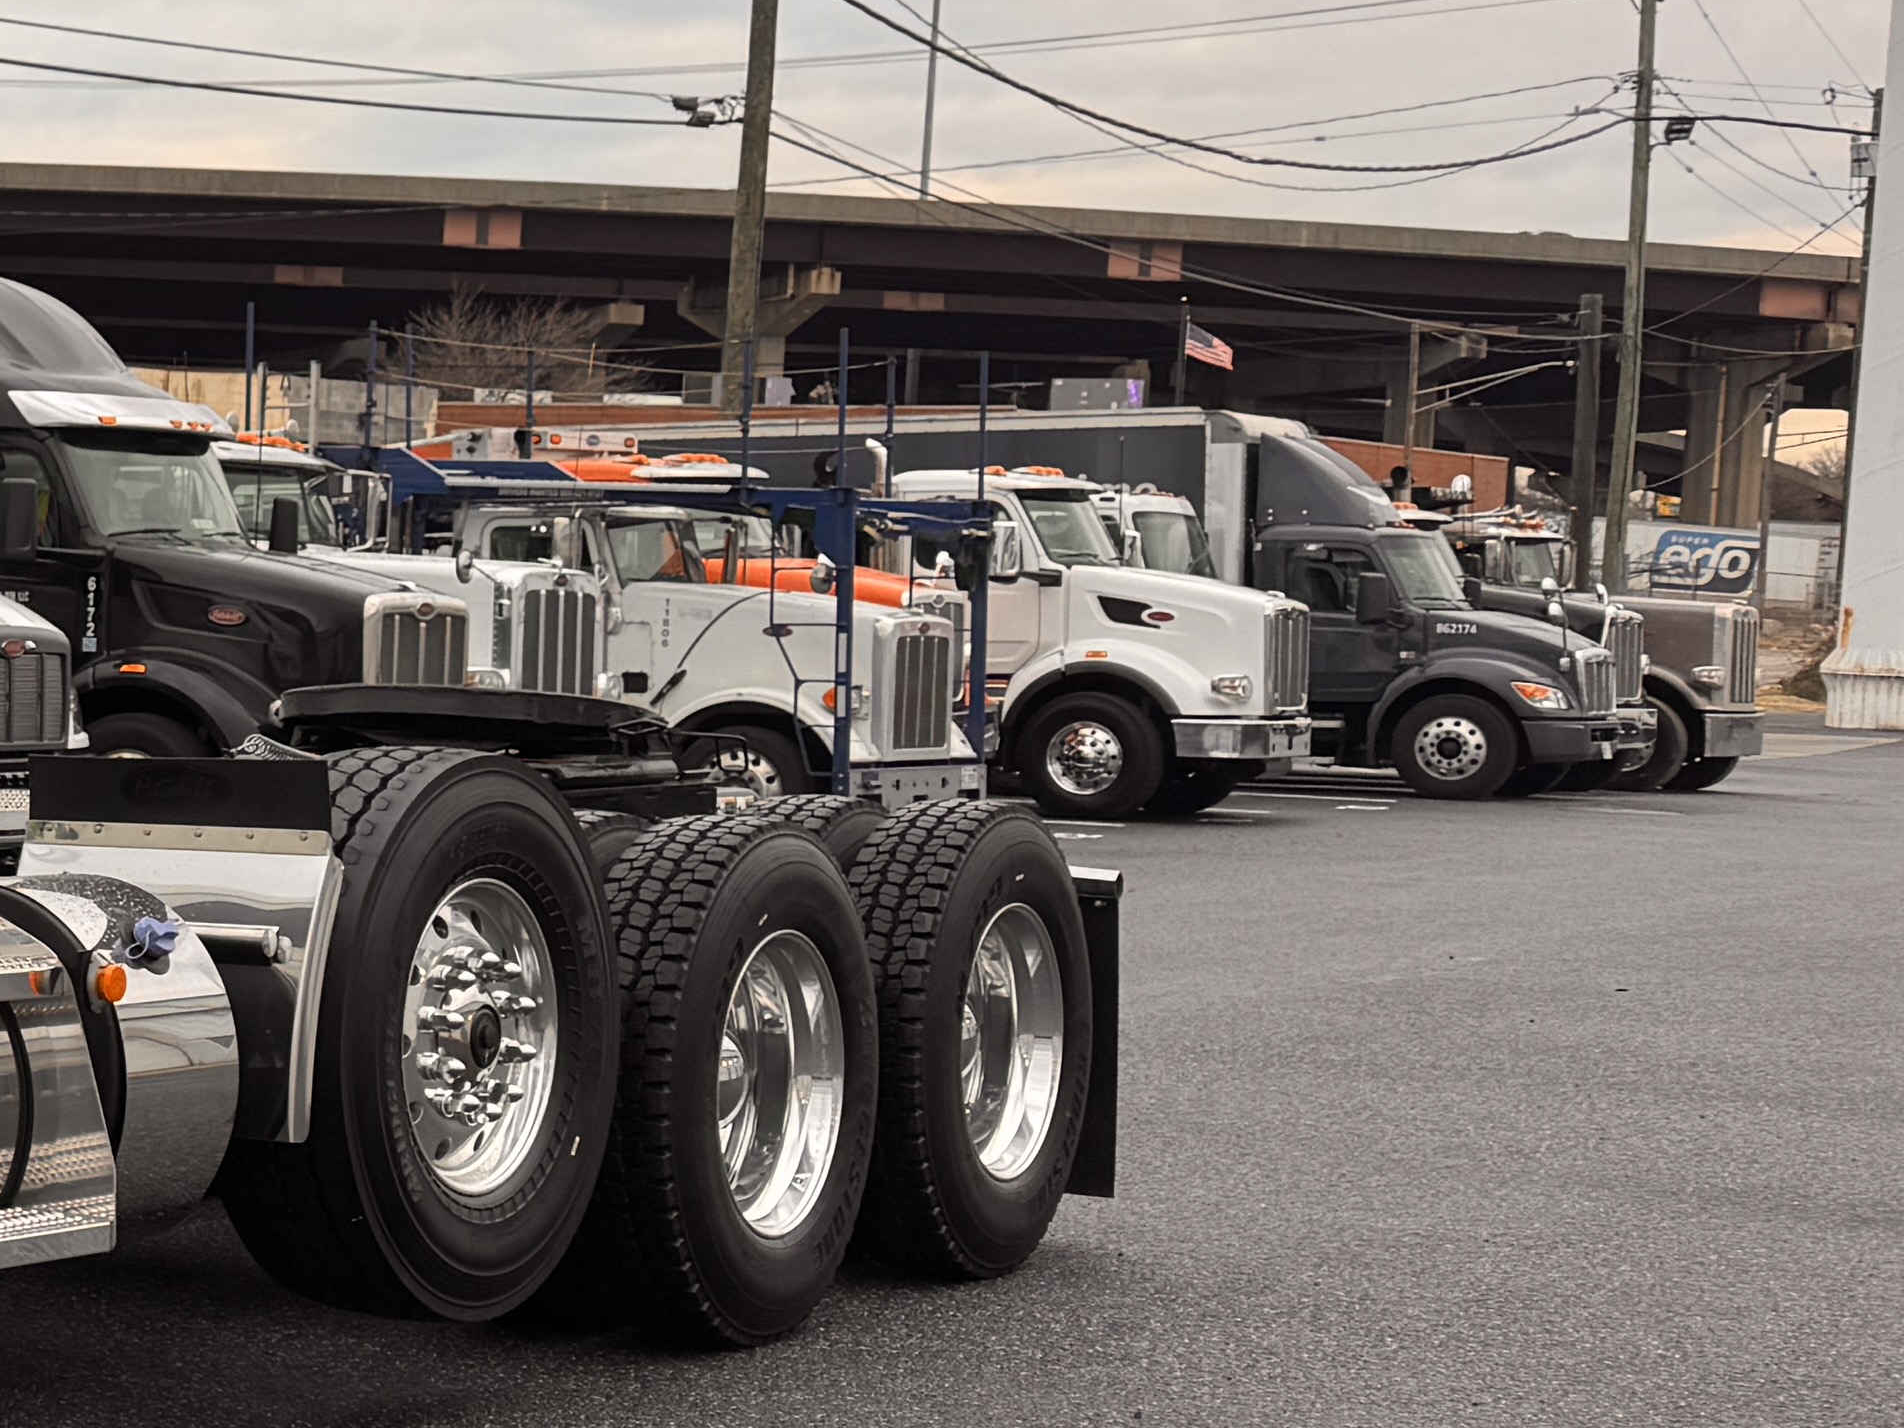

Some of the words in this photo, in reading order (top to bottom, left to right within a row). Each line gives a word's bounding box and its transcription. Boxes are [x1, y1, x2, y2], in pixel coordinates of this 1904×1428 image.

[1654, 539, 1756, 586] ego
[86, 576, 97, 637] 6172
[1436, 623, 1478, 634] 862174
